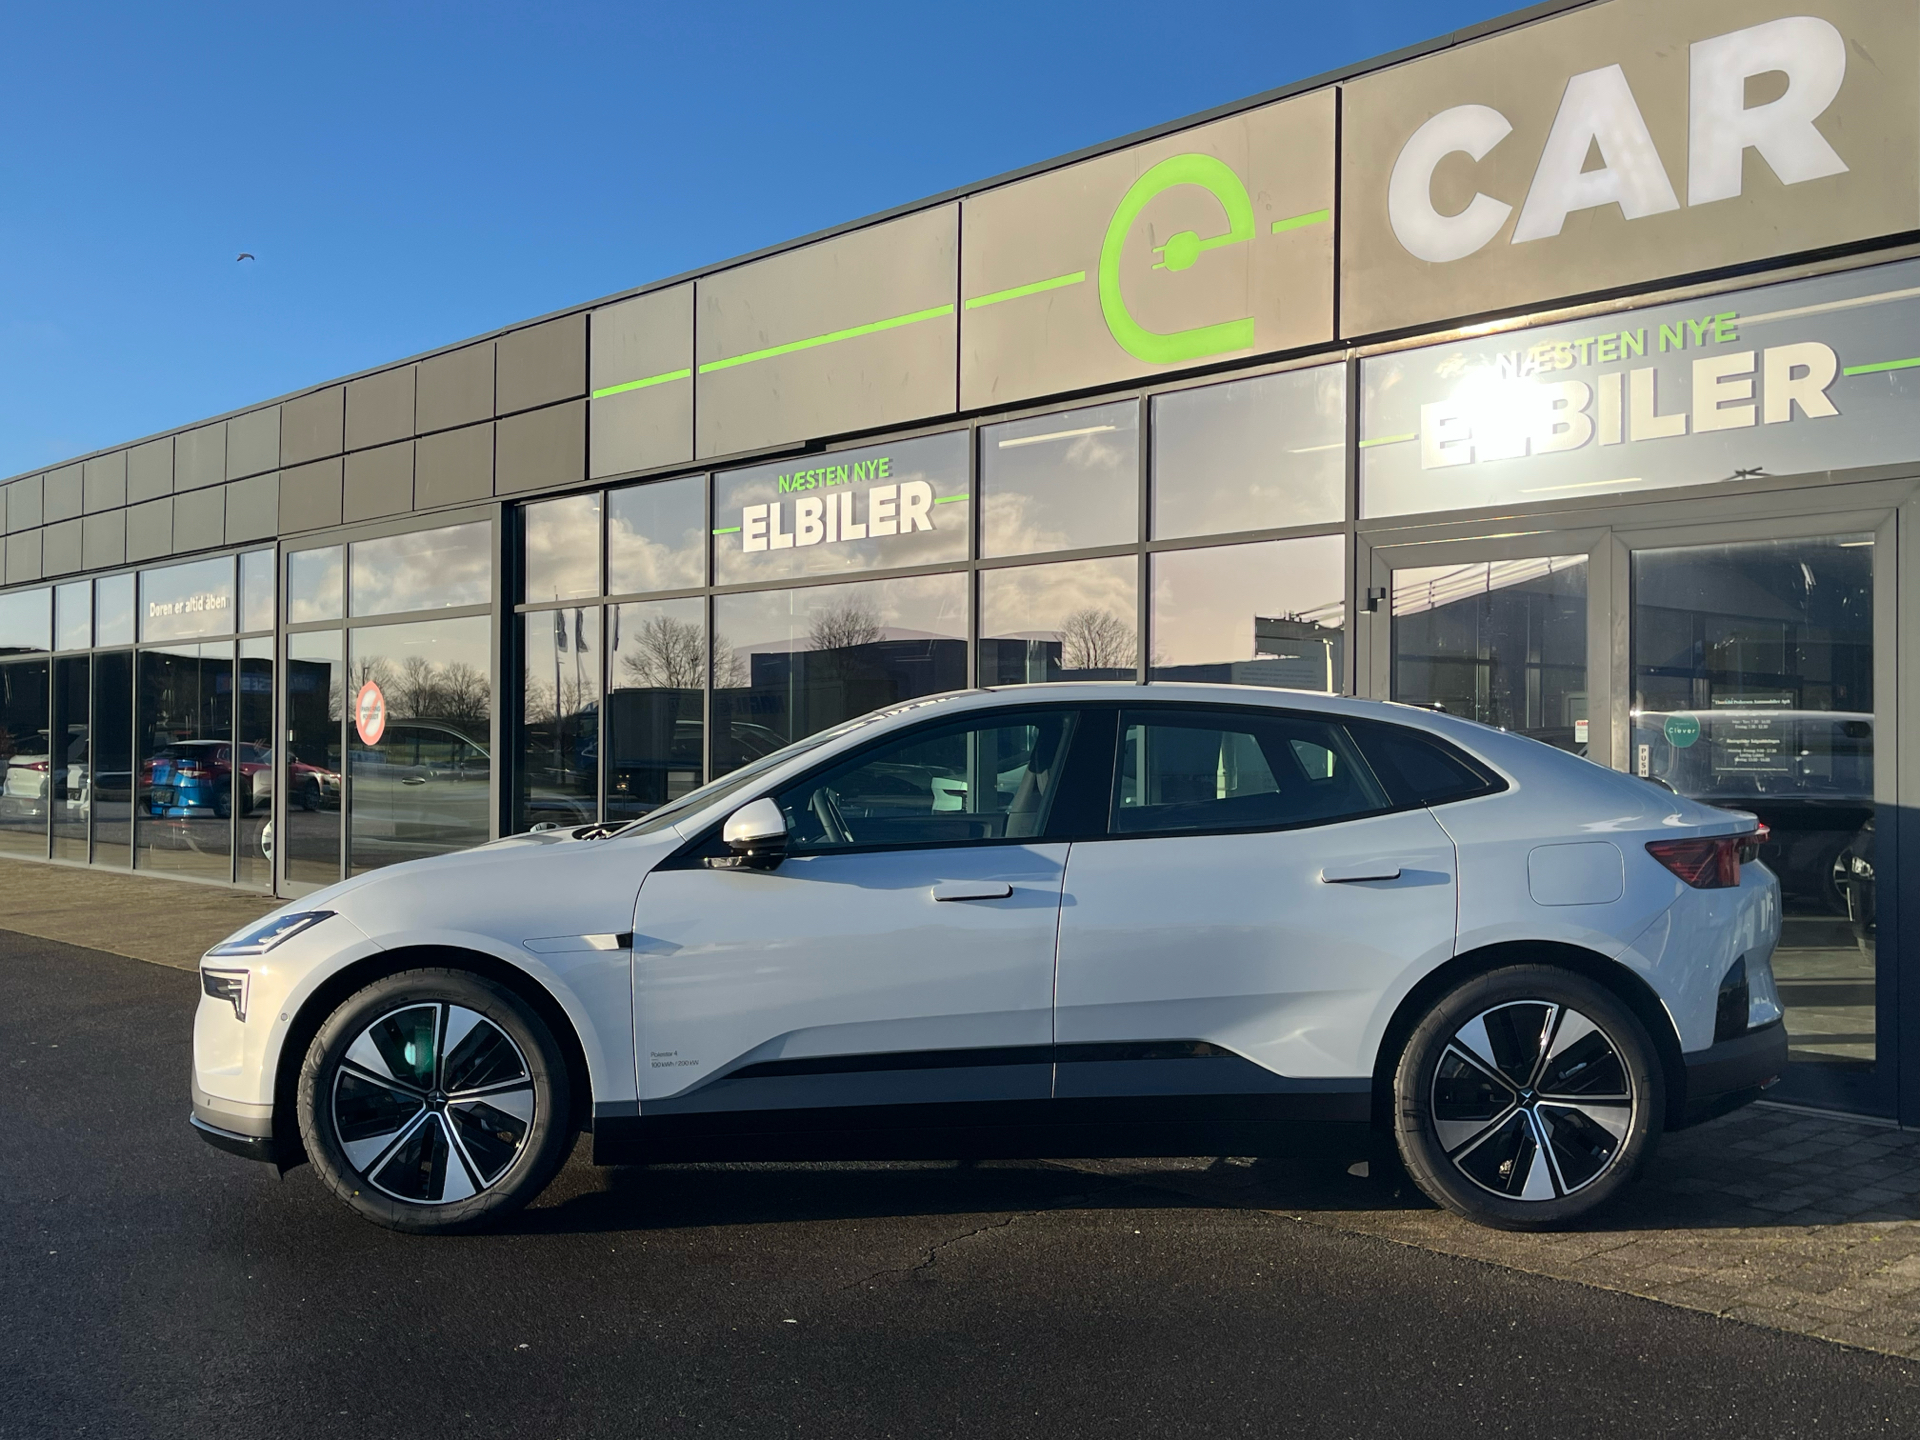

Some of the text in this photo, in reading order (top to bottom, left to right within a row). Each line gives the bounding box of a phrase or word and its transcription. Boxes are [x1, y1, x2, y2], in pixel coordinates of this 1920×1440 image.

[1388, 16, 1850, 263] CAR
[1659, 311, 1737, 353] NYE
[1421, 341, 1840, 470] EBILER
[778, 457, 890, 494] NÆSTEN NYE
[742, 480, 934, 553] ELBILER
[174, 601, 184, 614] er
[185, 595, 203, 613] altid
